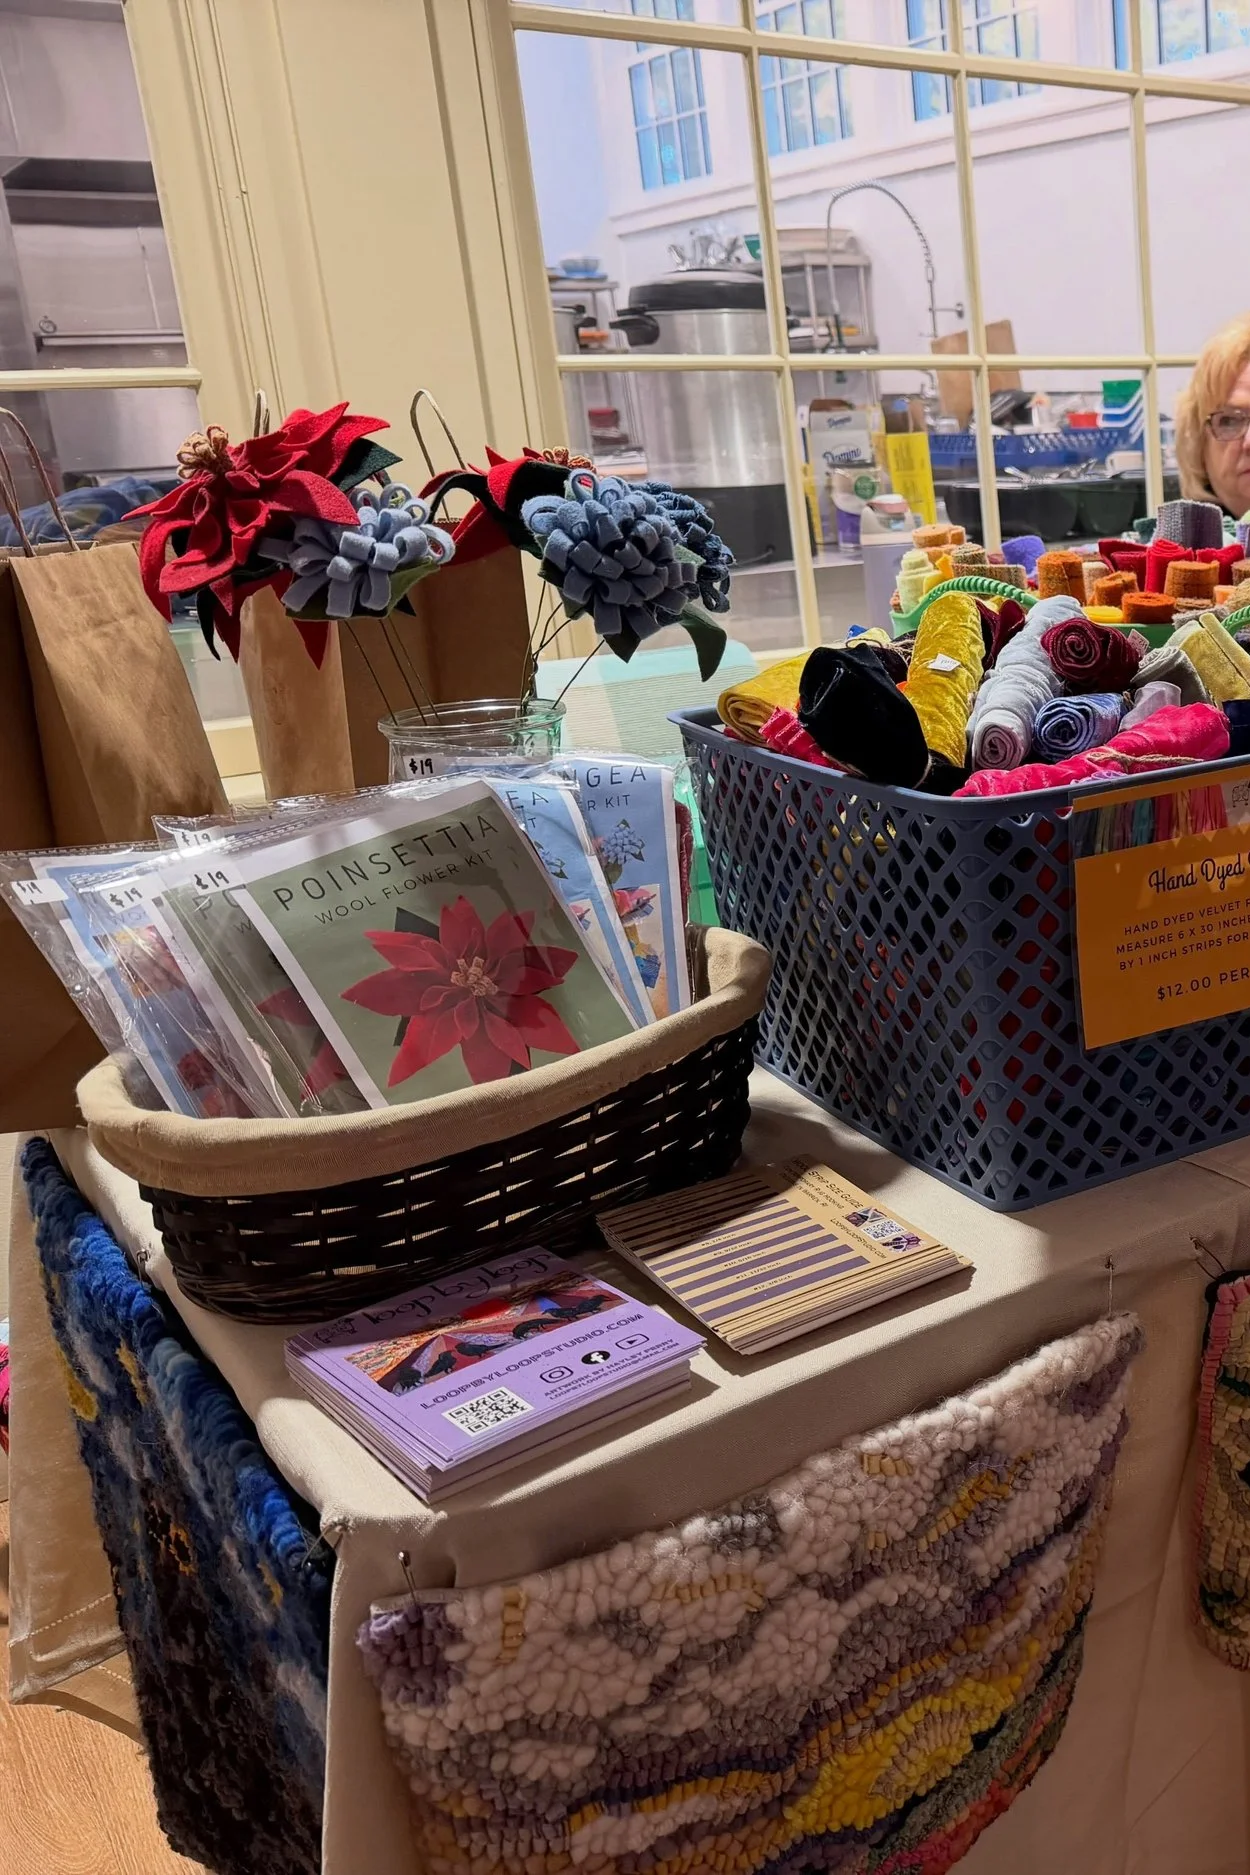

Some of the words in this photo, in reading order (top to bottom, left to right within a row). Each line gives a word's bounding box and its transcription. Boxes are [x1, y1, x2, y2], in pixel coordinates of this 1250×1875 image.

[408, 757, 435, 776] $19
[604, 794, 632, 810] KIT
[194, 870, 230, 891] $19
[272, 815, 499, 911] POINSETTIA
[1148, 866, 1198, 894] Hand
[1200, 856, 1245, 892] Dyed
[109, 887, 143, 908] $19
[314, 895, 377, 925] WOOL
[381, 863, 460, 900] FLOWER
[464, 848, 493, 868] KIT
[1124, 919, 1159, 936] HAND
[1163, 912, 1195, 927] DYED
[1198, 900, 1242, 918] VELVET
[1116, 934, 1174, 955] MEASURE
[1178, 931, 1185, 940] 6
[1189, 928, 1196, 937] X
[1200, 922, 1214, 935] 30
[1119, 960, 1134, 971] BY
[1138, 957, 1144, 966] 1
[1149, 949, 1178, 964] INCH
[1182, 937, 1223, 956] STRIPS
[1227, 932, 1250, 945] FOR
[1157, 976, 1212, 1001] $12.00
[1219, 967, 1250, 985] PER
[362, 1294, 435, 1326] loop
[430, 1275, 492, 1299] by
[480, 1254, 551, 1284] loop
[420, 1312, 645, 1410] LOOPBYLOOPSTUDIO.COM
[543, 1372, 592, 1397] ARTWORK
[591, 1366, 605, 1378] BY
[604, 1350, 644, 1371] HAYLEY
[643, 1338, 676, 1356] PERRY
